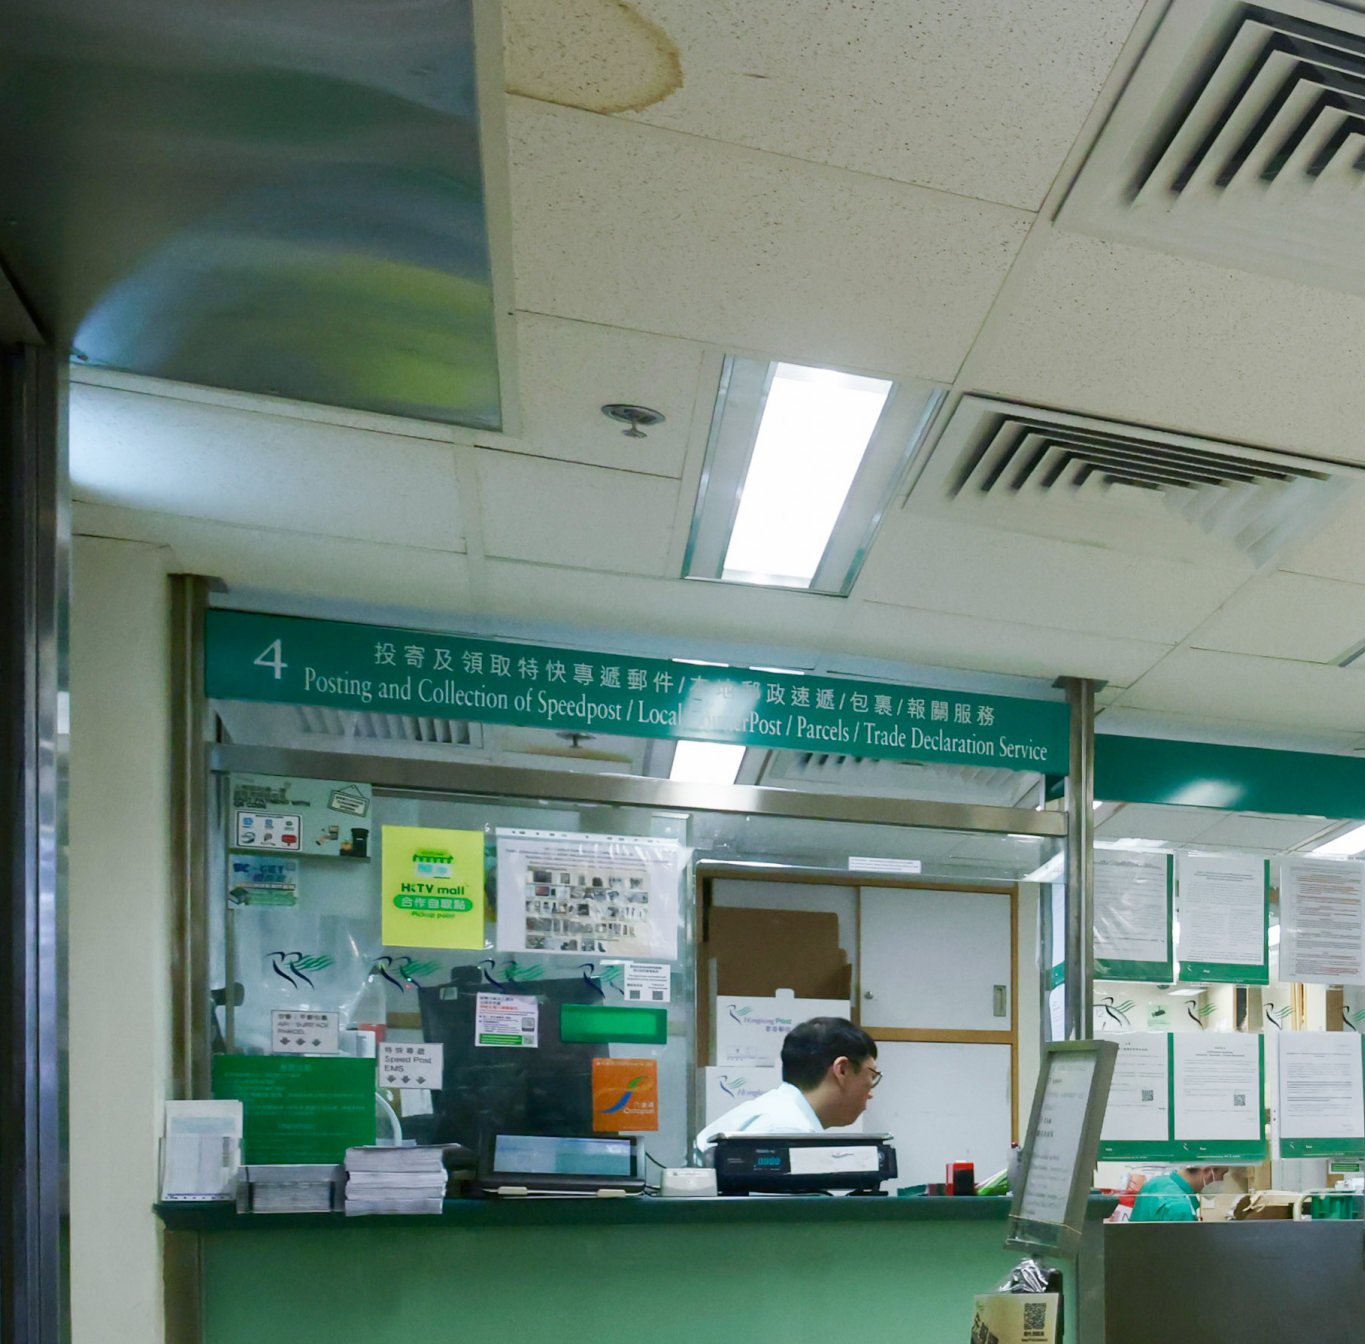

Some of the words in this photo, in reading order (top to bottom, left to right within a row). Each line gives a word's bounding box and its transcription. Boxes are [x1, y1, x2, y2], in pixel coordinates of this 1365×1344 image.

[254, 639, 288, 680] 4
[304, 668, 372, 702] Posting
[379, 674, 412, 701] and
[418, 680, 508, 710] Collection
[514, 686, 533, 713] of
[538, 690, 622, 727] Speedpost
[638, 699, 682, 726] Local
[797, 720, 849, 743] Parcels
[864, 722, 905, 747] Trade
[911, 728, 995, 755] Declaration
[999, 739, 1048, 762] Service
[384, 1055, 411, 1064] Speed
[413, 1056, 432, 1064] Post
